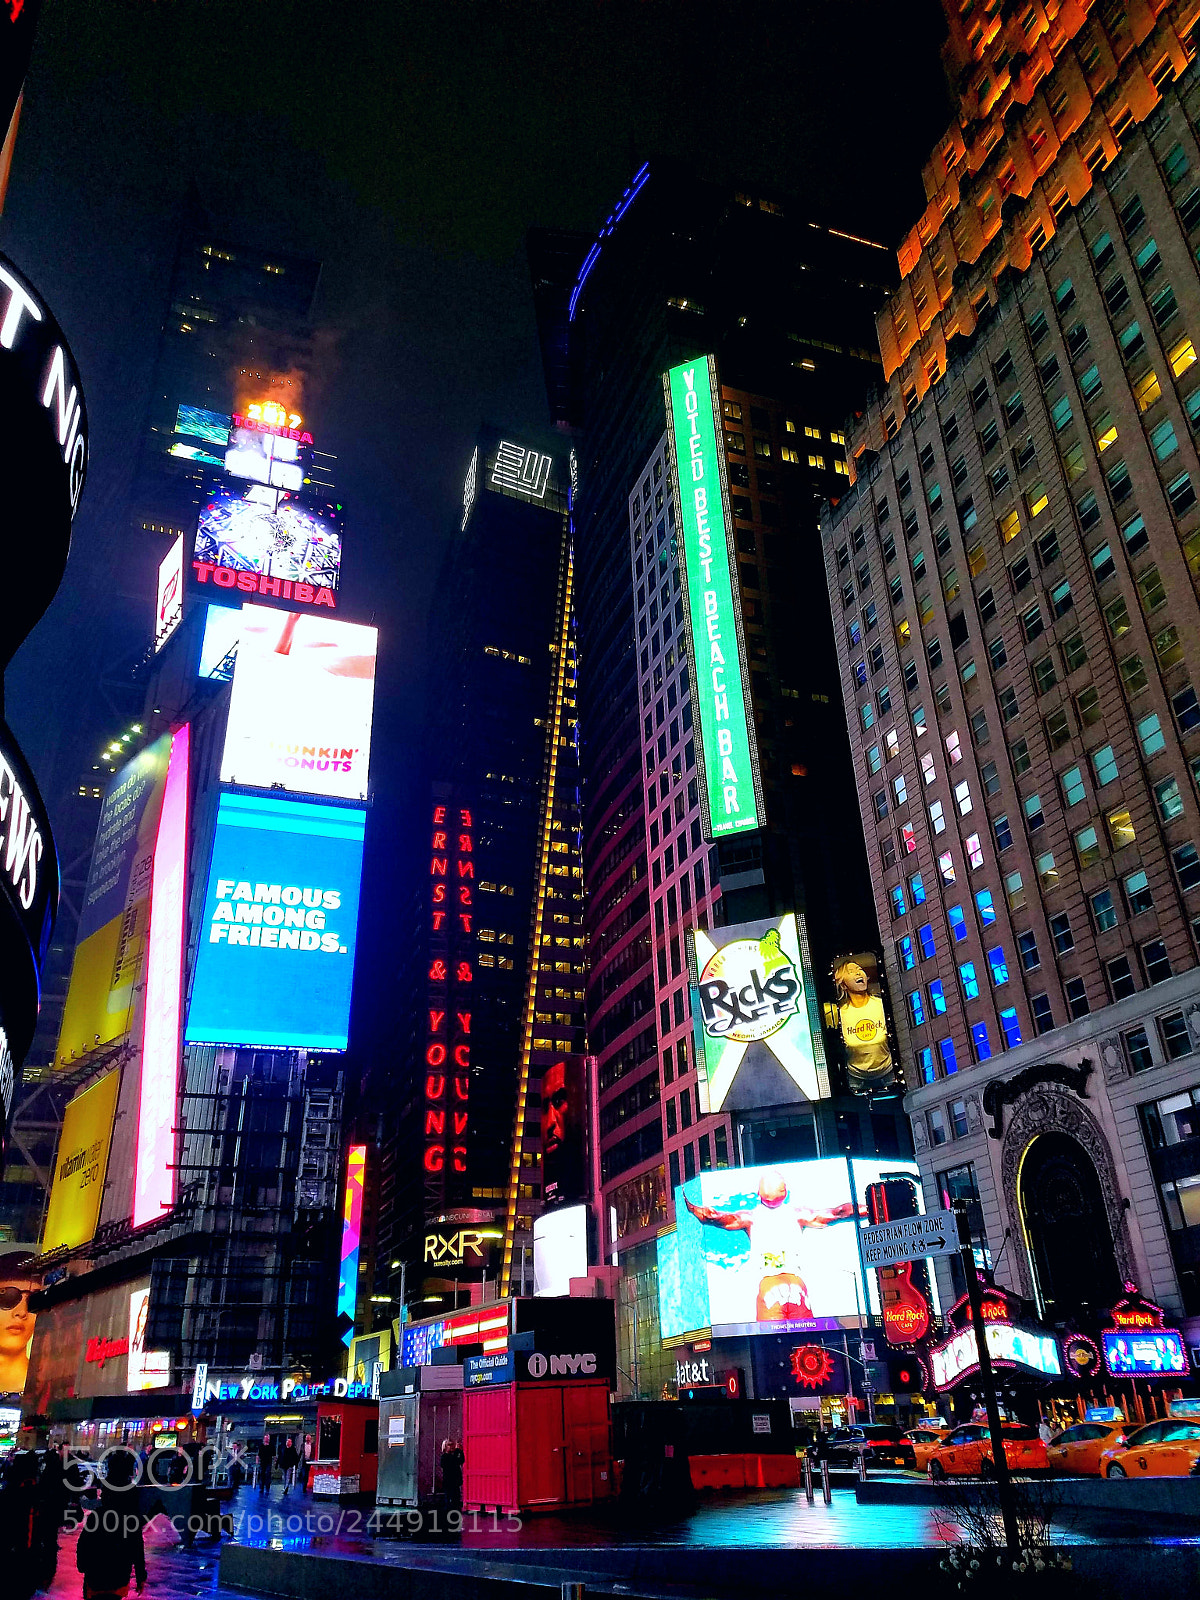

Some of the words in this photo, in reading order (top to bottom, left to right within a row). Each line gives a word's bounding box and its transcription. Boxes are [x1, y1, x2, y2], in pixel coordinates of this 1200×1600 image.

[232, 413, 314, 445] TOSHIBA
[193, 561, 336, 608] TOSHIBA
[683, 368, 705, 482] VOTED
[694, 487, 713, 583] BEST
[704, 590, 730, 721] BEACH
[717, 728, 740, 815] BAR
[278, 757, 352, 772] ONUTS
[431, 806, 448, 931] ERNST
[216, 879, 341, 910] FAMOUS
[212, 901, 326, 930] AMONG
[209, 922, 347, 954] FRIENDS.
[430, 959, 447, 981] &
[424, 1010, 447, 1172] YOUNG
[863, 1227, 903, 1246] PEDESTRIAN
[903, 1221, 923, 1237] FLOW
[924, 1217, 945, 1233] ZONE
[424, 1231, 483, 1262] RXR
[865, 1247, 880, 1262] KEEP
[882, 1242, 909, 1258] MOVING
[886, 1311, 905, 1322] Hard
[906, 1309, 926, 1323] Rock
[470, 1360, 478, 1370] The
[479, 1358, 494, 1369] Official
[495, 1356, 508, 1366] Guide
[550, 1353, 597, 1375] NYC
[681, 1359, 709, 1384] at&t
[195, 1365, 205, 1407] NYPD
[241, 1377, 279, 1400] YORK
